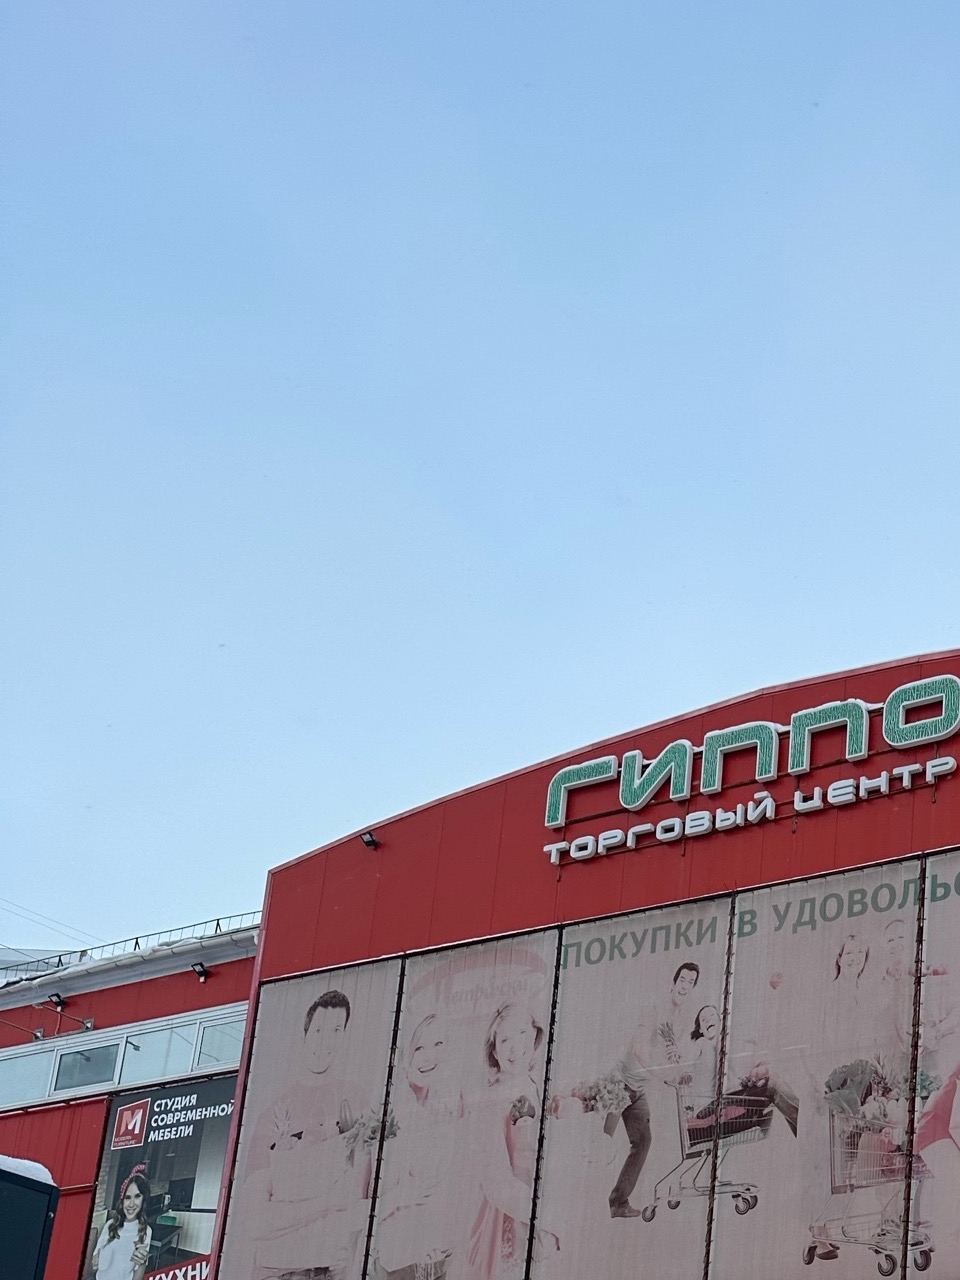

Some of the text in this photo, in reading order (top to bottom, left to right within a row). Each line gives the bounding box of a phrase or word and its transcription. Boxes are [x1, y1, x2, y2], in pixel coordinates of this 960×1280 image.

[543, 756, 957, 865] ТОРГОВЫЙ ЦЕНТР
[562, 916, 717, 970] ПОКУПКИ
[736, 909, 758, 938] В
[151, 1100, 234, 1127] СОВРЕМЕННОЙ
[154, 1094, 198, 1112] СТУДИЯ
[148, 1125, 194, 1142] МЕБЕЛИ
